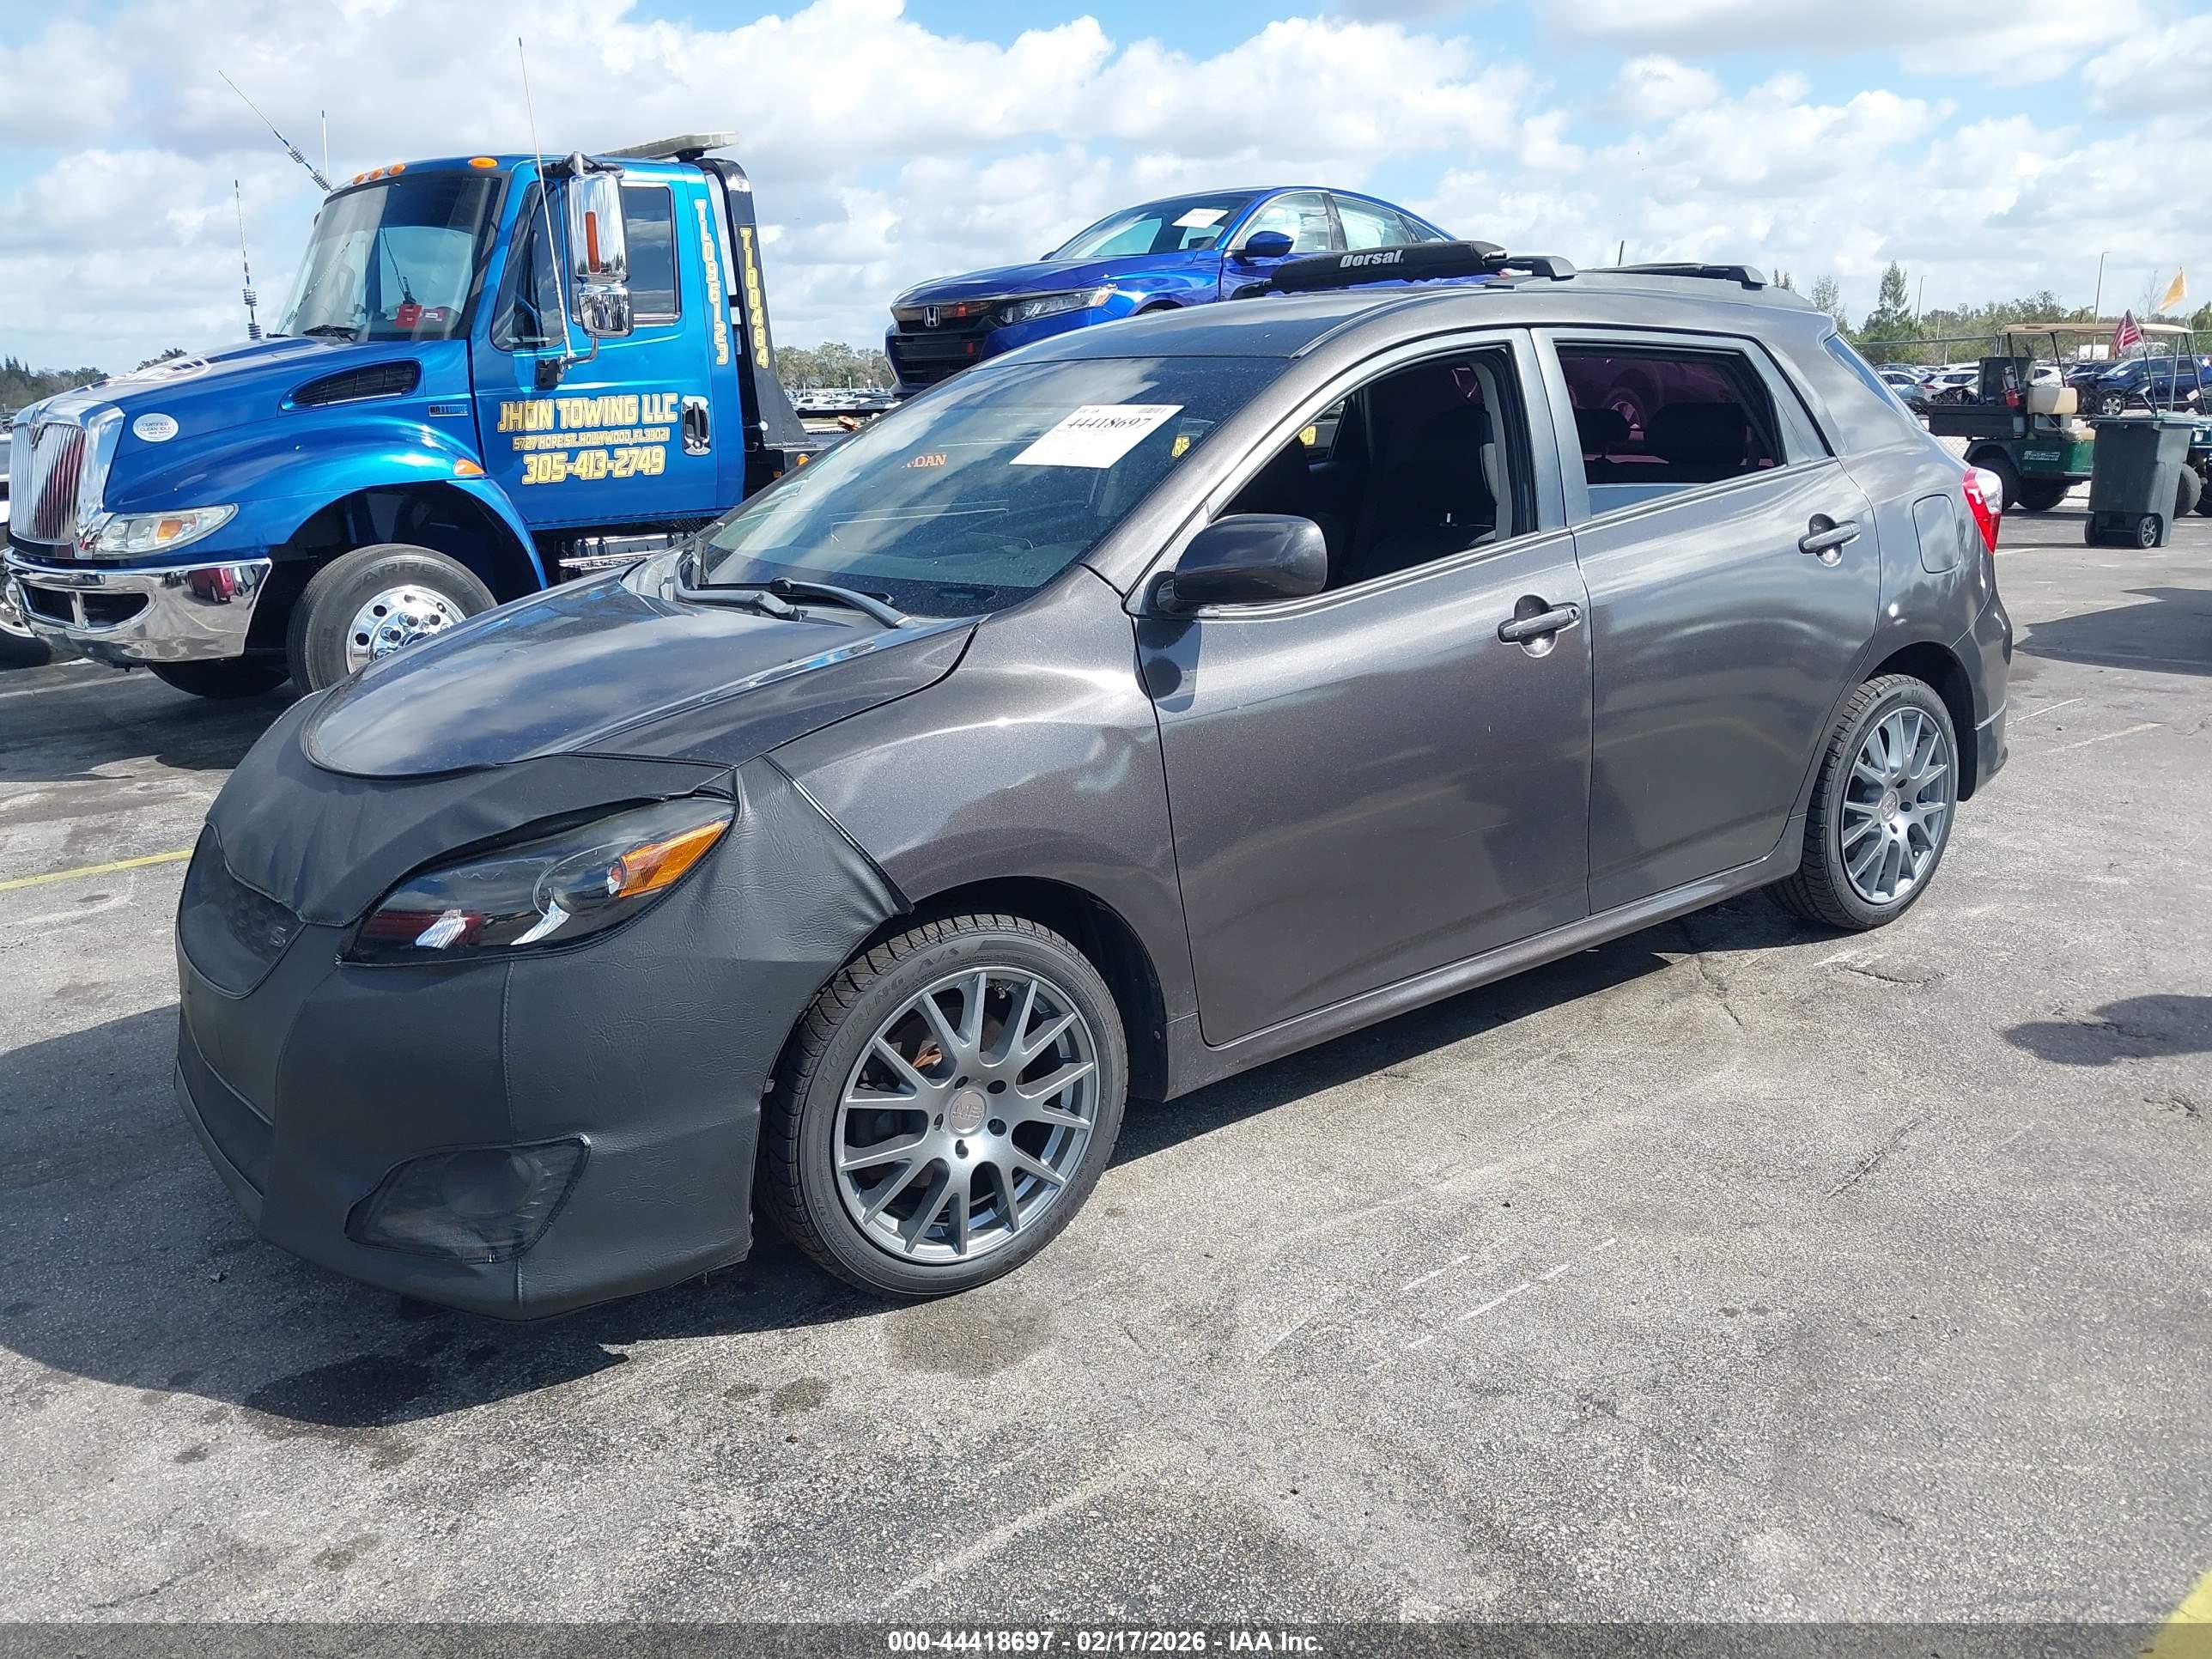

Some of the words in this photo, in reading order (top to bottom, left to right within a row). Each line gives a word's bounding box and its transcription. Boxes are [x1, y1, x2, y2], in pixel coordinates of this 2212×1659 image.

[498, 399, 554, 431] JHON
[557, 396, 638, 428] TOWING
[642, 393, 678, 423] LLC
[1067, 417, 1153, 428] 44418697
[523, 447, 665, 483] 305-413-2749
